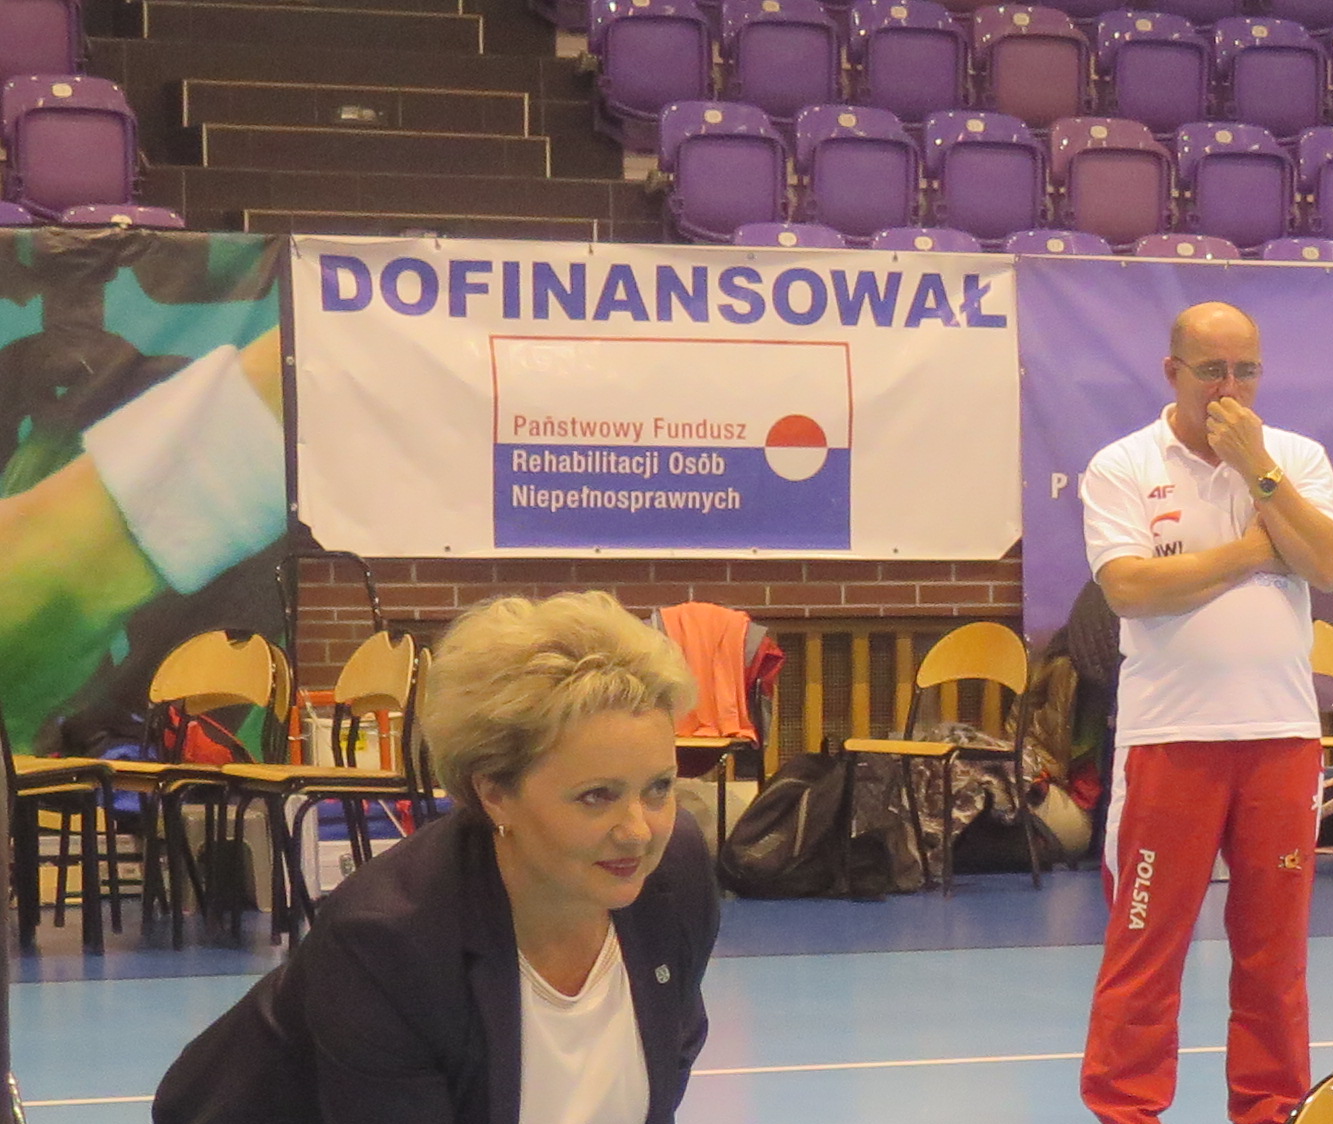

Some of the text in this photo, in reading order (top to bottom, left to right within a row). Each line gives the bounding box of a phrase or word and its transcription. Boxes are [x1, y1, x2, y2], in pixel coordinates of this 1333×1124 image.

[319, 254, 1008, 329] DOFINANSOWAŁ
[513, 415, 747, 443] Państwowy Fundusz
[512, 449, 726, 479] Rehabilitacji Osób
[512, 484, 742, 515] Niepełnosprawnych
[1128, 848, 1156, 930] POLSKA
